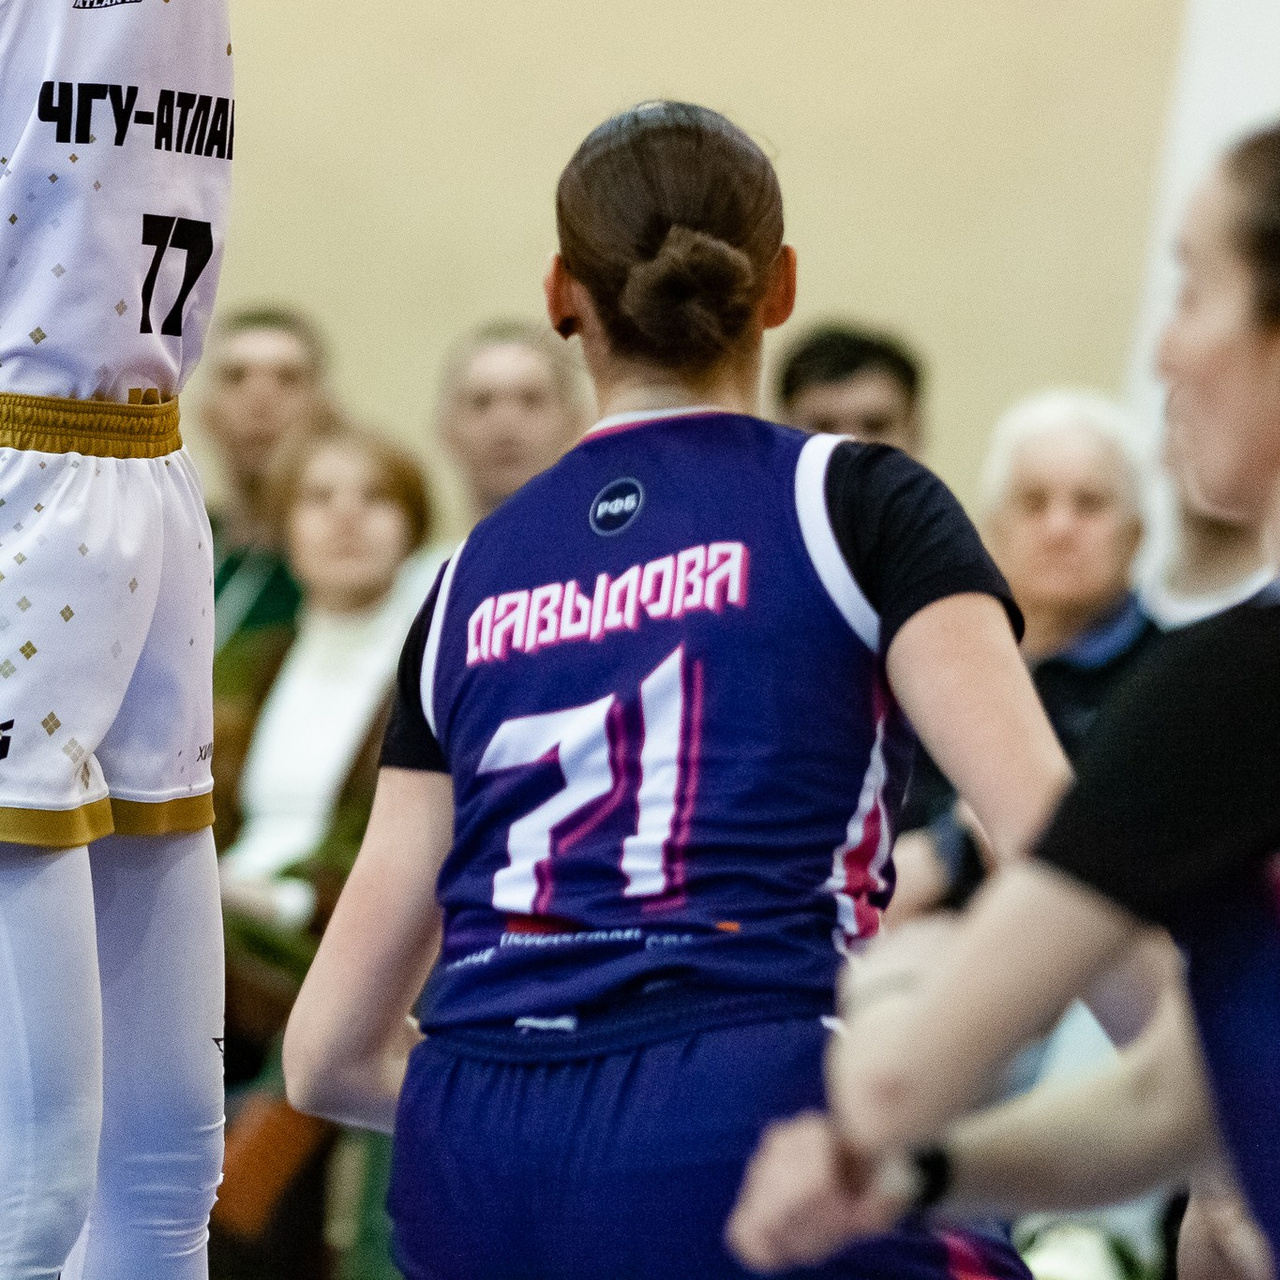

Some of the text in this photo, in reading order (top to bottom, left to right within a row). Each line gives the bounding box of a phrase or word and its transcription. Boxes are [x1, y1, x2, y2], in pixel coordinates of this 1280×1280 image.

[37, 80, 235, 161] ЧГУ-АТЛА
[139, 213, 214, 337] 77
[596, 493, 638, 520] РФБ
[466, 541, 749, 665] ДАВЫДОВА
[476, 642, 694, 913] 71
